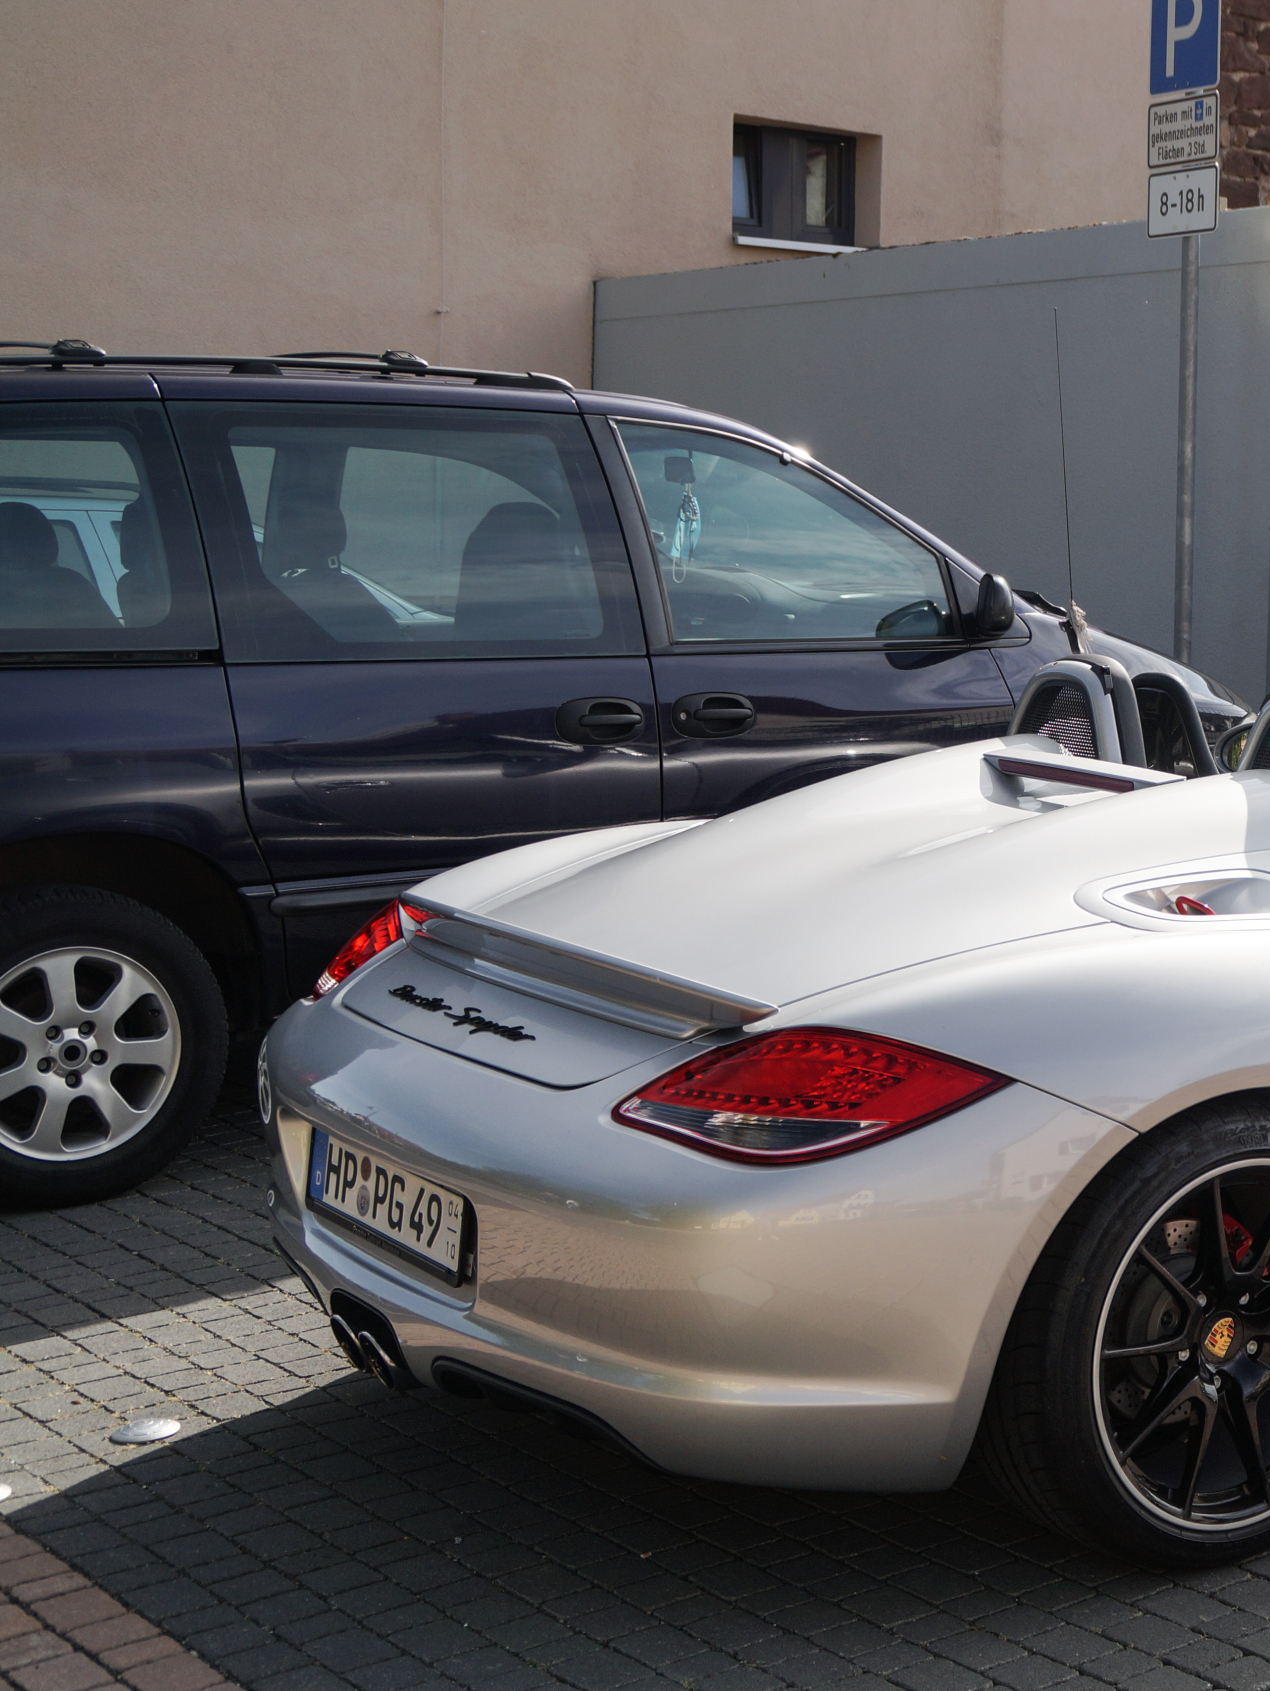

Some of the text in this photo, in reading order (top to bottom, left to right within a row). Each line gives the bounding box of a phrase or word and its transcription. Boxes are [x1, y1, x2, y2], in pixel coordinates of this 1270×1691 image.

[1166, 0, 1203, 77] P
[1153, 102, 1212, 126] Parken mit in
[1151, 123, 1214, 148] gekennzeichneten
[1157, 144, 1185, 161] Flächen
[316, 1170, 322, 1186] D
[447, 1201, 459, 1220] 04
[445, 1240, 456, 1260] 10
